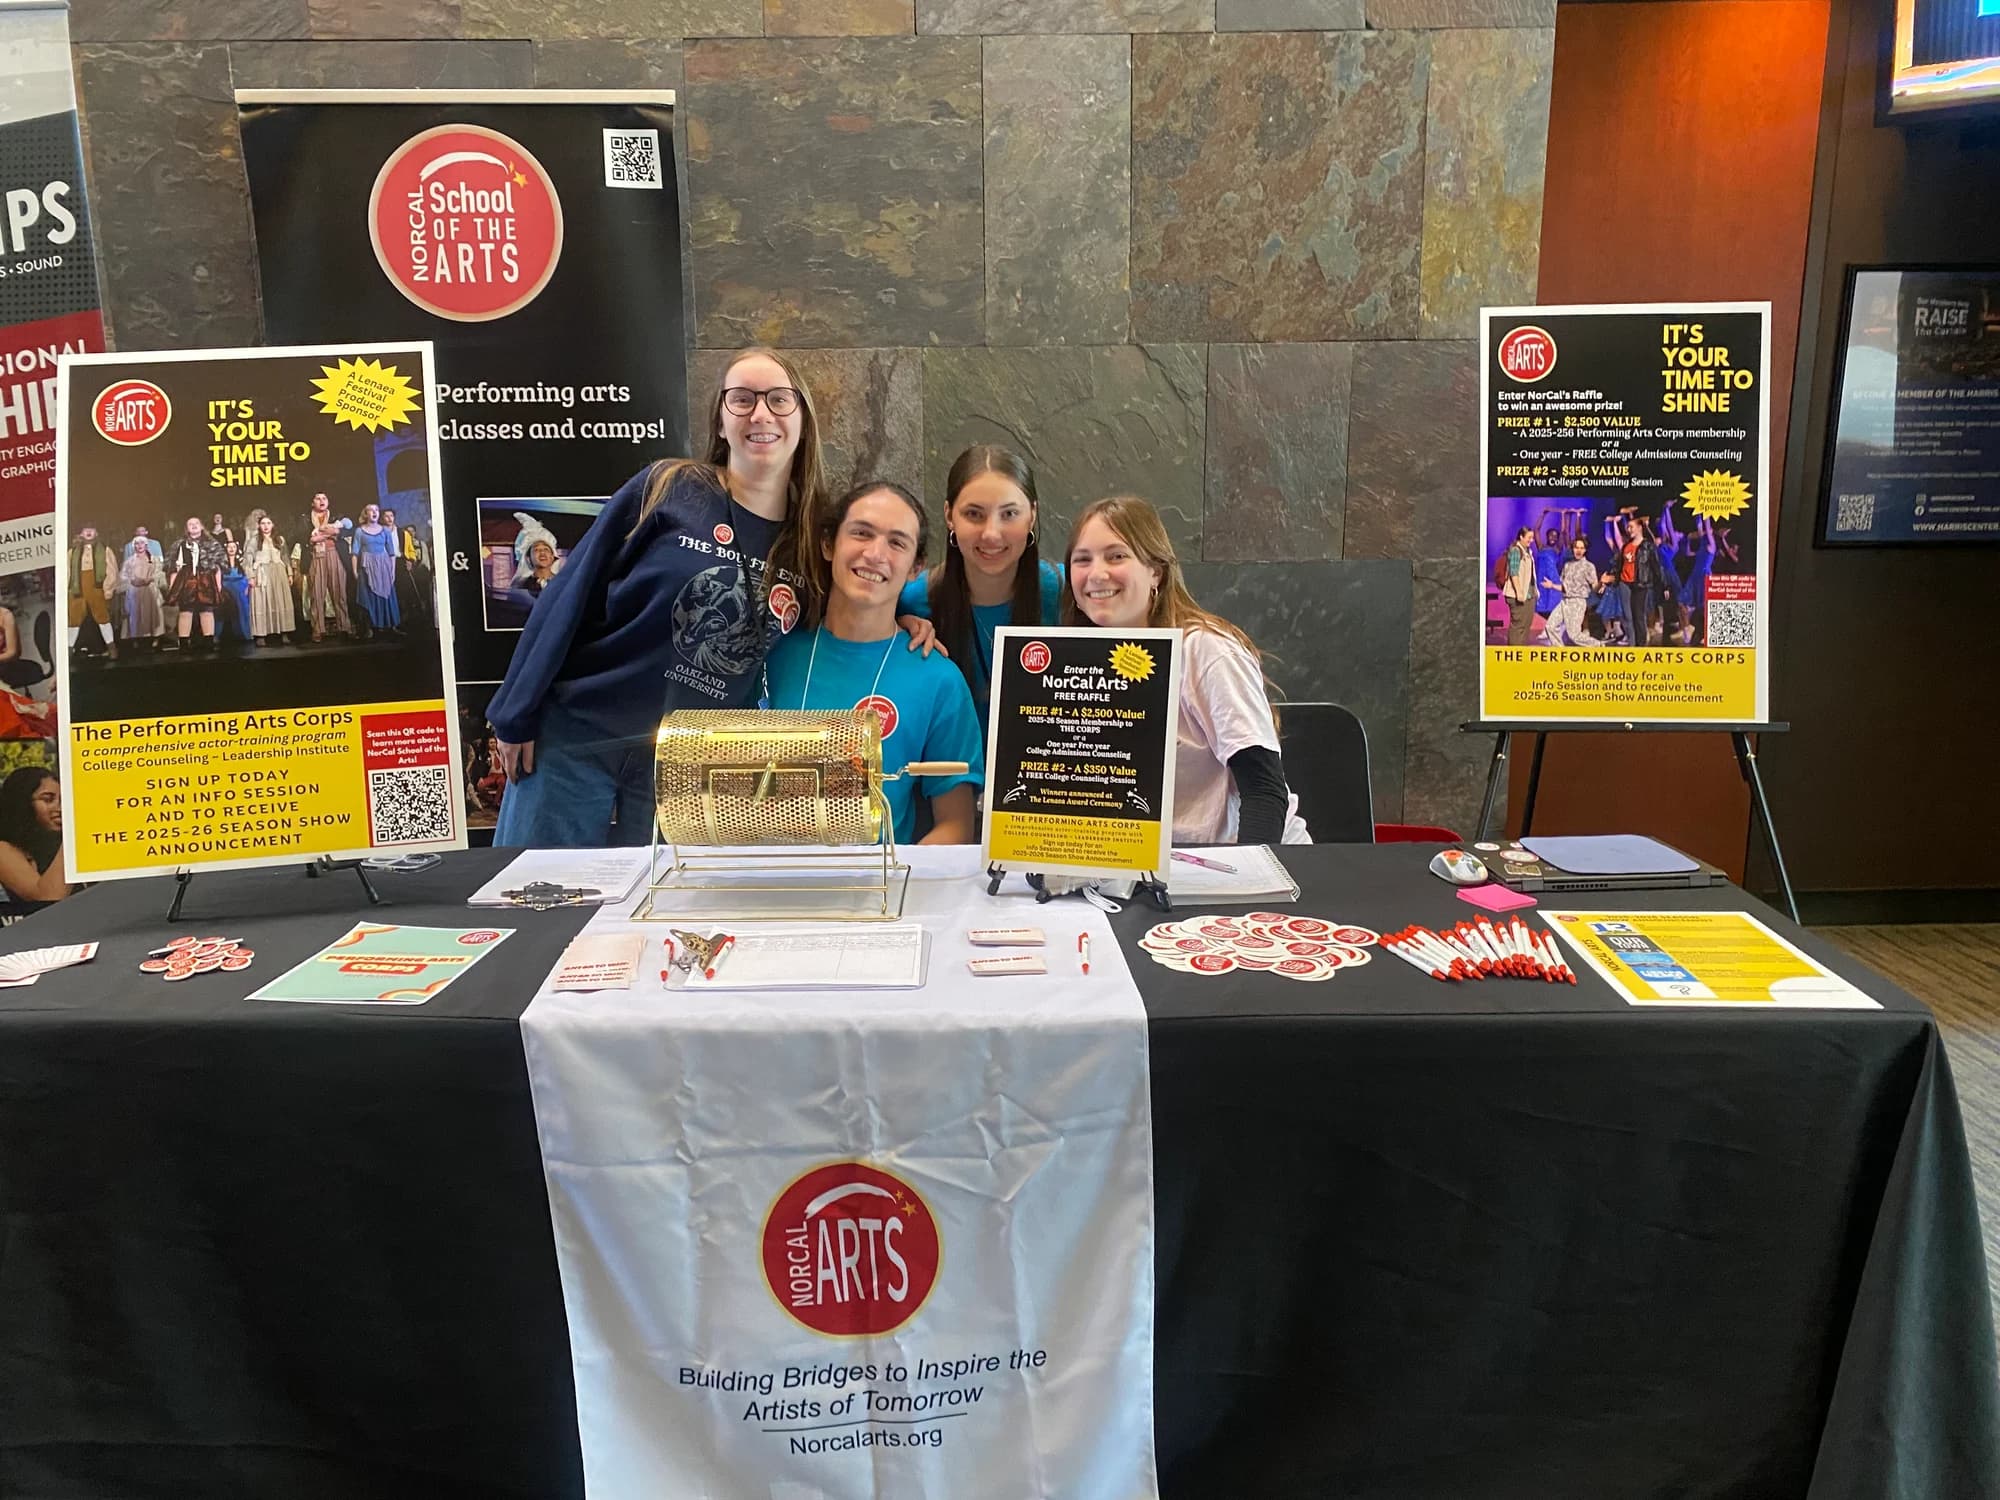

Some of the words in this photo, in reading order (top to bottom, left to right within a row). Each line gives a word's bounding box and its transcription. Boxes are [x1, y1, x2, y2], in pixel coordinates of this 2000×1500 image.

[429, 181, 514, 214] School
[0, 180, 76, 255] PS
[408, 185, 429, 281] NORCAL
[433, 219, 460, 240] OF
[473, 218, 517, 240] THE
[16, 255, 63, 274] SOUND
[434, 243, 519, 283] ARTS
[1915, 308, 1968, 326] RAISE
[1663, 324, 1703, 345] IT'S
[1515, 343, 1545, 370] ARTS
[1662, 347, 1730, 368] YOUR
[348, 372, 356, 380] A
[358, 374, 396, 395] Lenaea
[1662, 370, 1715, 390] TIME
[1721, 369, 1753, 390] TO
[338, 389, 388, 413] Producer
[345, 381, 387, 402] Festival
[436, 382, 574, 406] Performing
[580, 384, 630, 402] arts
[1498, 391, 1526, 400] Enter
[1527, 390, 1571, 400] NorCal's
[1573, 390, 1603, 400] Raffle
[1662, 392, 1730, 412] SHINE
[105, 401, 115, 432] NORCAL
[116, 400, 156, 431] ARTS
[208, 400, 254, 420] IT'S
[336, 399, 380, 421] Sponsor
[1498, 402, 1509, 411] to
[1511, 401, 1529, 410] win
[1530, 403, 1543, 411] an
[1545, 402, 1592, 411] awesome
[1594, 401, 1623, 412] prize!
[208, 421, 283, 441] YOUR
[438, 420, 523, 440] classes
[528, 418, 574, 439] and
[580, 418, 665, 443] camps!
[1497, 417, 1530, 427] PRIZE
[1533, 417, 1542, 427] #
[1546, 417, 1550, 427] 1
[1564, 416, 1600, 428] $2,500
[1602, 416, 1641, 427] VALUE
[1520, 428, 1527, 438] A
[1529, 428, 1574, 438] 2025-256
[1577, 428, 1631, 439] Performing
[1633, 428, 1653, 437] Arts
[1654, 428, 1684, 440] Corps
[1686, 427, 1746, 440] membership
[209, 443, 268, 464] TIME
[274, 442, 310, 461] TO
[1520, 450, 1540, 459] One
[1541, 451, 1562, 461] year
[1573, 450, 1597, 459] FREE
[1599, 450, 1632, 461] College
[1635, 449, 1687, 459] Admissions
[1690, 450, 1743, 461] Counseling
[209, 465, 286, 487] SHINE
[452, 552, 469, 570] &
[678, 535, 712, 553] THE
[749, 558, 805, 588] FREND
[1495, 651, 1523, 662] THE
[1530, 651, 1636, 663] PERFORMING
[1643, 652, 1684, 663] ARTS
[1691, 652, 1746, 664] CORPS
[675, 664, 726, 690] OAKLAND
[1064, 666, 1088, 674] Enter
[1089, 666, 1104, 675] the
[1563, 670, 1587, 682] Sign
[1589, 672, 1603, 682] up
[1606, 671, 1639, 682] today
[1641, 670, 1657, 680] for
[1660, 672, 1674, 680] an
[664, 670, 729, 701] UNIVERSITY
[1042, 675, 1093, 689] NorCal
[1096, 676, 1128, 691] Arts
[1054, 692, 1076, 700] FREE
[1077, 693, 1110, 702] RAFFLE
[1513, 691, 1559, 701] 2025-26
[1562, 691, 1601, 701] Season
[1604, 692, 1634, 702] Show
[1636, 692, 1723, 703] Announcement
[1019, 706, 1048, 715] PRIZE
[1050, 707, 1063, 716] #1
[1072, 708, 1079, 717] A
[1081, 707, 1113, 718] $2,500
[1114, 709, 1146, 719] Value!
[72, 725, 112, 741] The
[119, 717, 239, 738] Performing
[245, 715, 287, 730] Arts
[293, 711, 353, 728] Corps
[366, 730, 386, 738] Scan
[387, 729, 402, 737] this
[402, 727, 415, 736] QR
[416, 727, 435, 735] code
[81, 749, 90, 757] a
[93, 741, 195, 756] comprehensive
[198, 735, 289, 749] actor-training
[292, 731, 346, 744] program
[367, 748, 396, 757] NorCal
[397, 746, 423, 755] School
[424, 745, 433, 753] of
[434, 744, 446, 752] the
[395, 738, 416, 746] more
[417, 736, 440, 744] about
[82, 760, 133, 771] College
[136, 754, 209, 768] Counseling
[222, 747, 293, 761] Leadership
[296, 744, 350, 756] Institute
[398, 756, 417, 764] Arts!
[146, 777, 189, 790] SIGN
[198, 775, 220, 786] UP
[228, 769, 289, 783] TODAY
[116, 796, 152, 809] FOR
[160, 794, 185, 805] AN
[193, 790, 236, 803] INFO
[244, 783, 319, 799] SESSION
[146, 810, 184, 823] AND
[192, 808, 215, 820] TO
[223, 801, 299, 817] RECEIVE
[1011, 815, 1025, 823] THE
[1028, 816, 1083, 826] PERFORMING
[1086, 820, 1108, 828] ARTS
[1111, 822, 1141, 830] CORPS
[92, 832, 128, 844] THE
[136, 824, 213, 841] 2025-26
[220, 818, 291, 834] SEASON
[300, 813, 351, 827] SHOW
[146, 834, 302, 856] ANNOUNCEMENT
[350, 963, 416, 973] CORPS
[785, 1220, 814, 1307] NORCAL
[816, 1216, 909, 1305] ARTS
[680, 1367, 773, 1394] Building
[783, 1362, 877, 1389] Bridges
[886, 1365, 907, 1382] to
[916, 1354, 1000, 1384] Inspire
[1010, 1348, 1047, 1370] the
[743, 1399, 821, 1422] Artists
[830, 1393, 855, 1415] of
[862, 1386, 984, 1413] Tomorrow
[789, 1428, 942, 1454] Norcalarts.org
